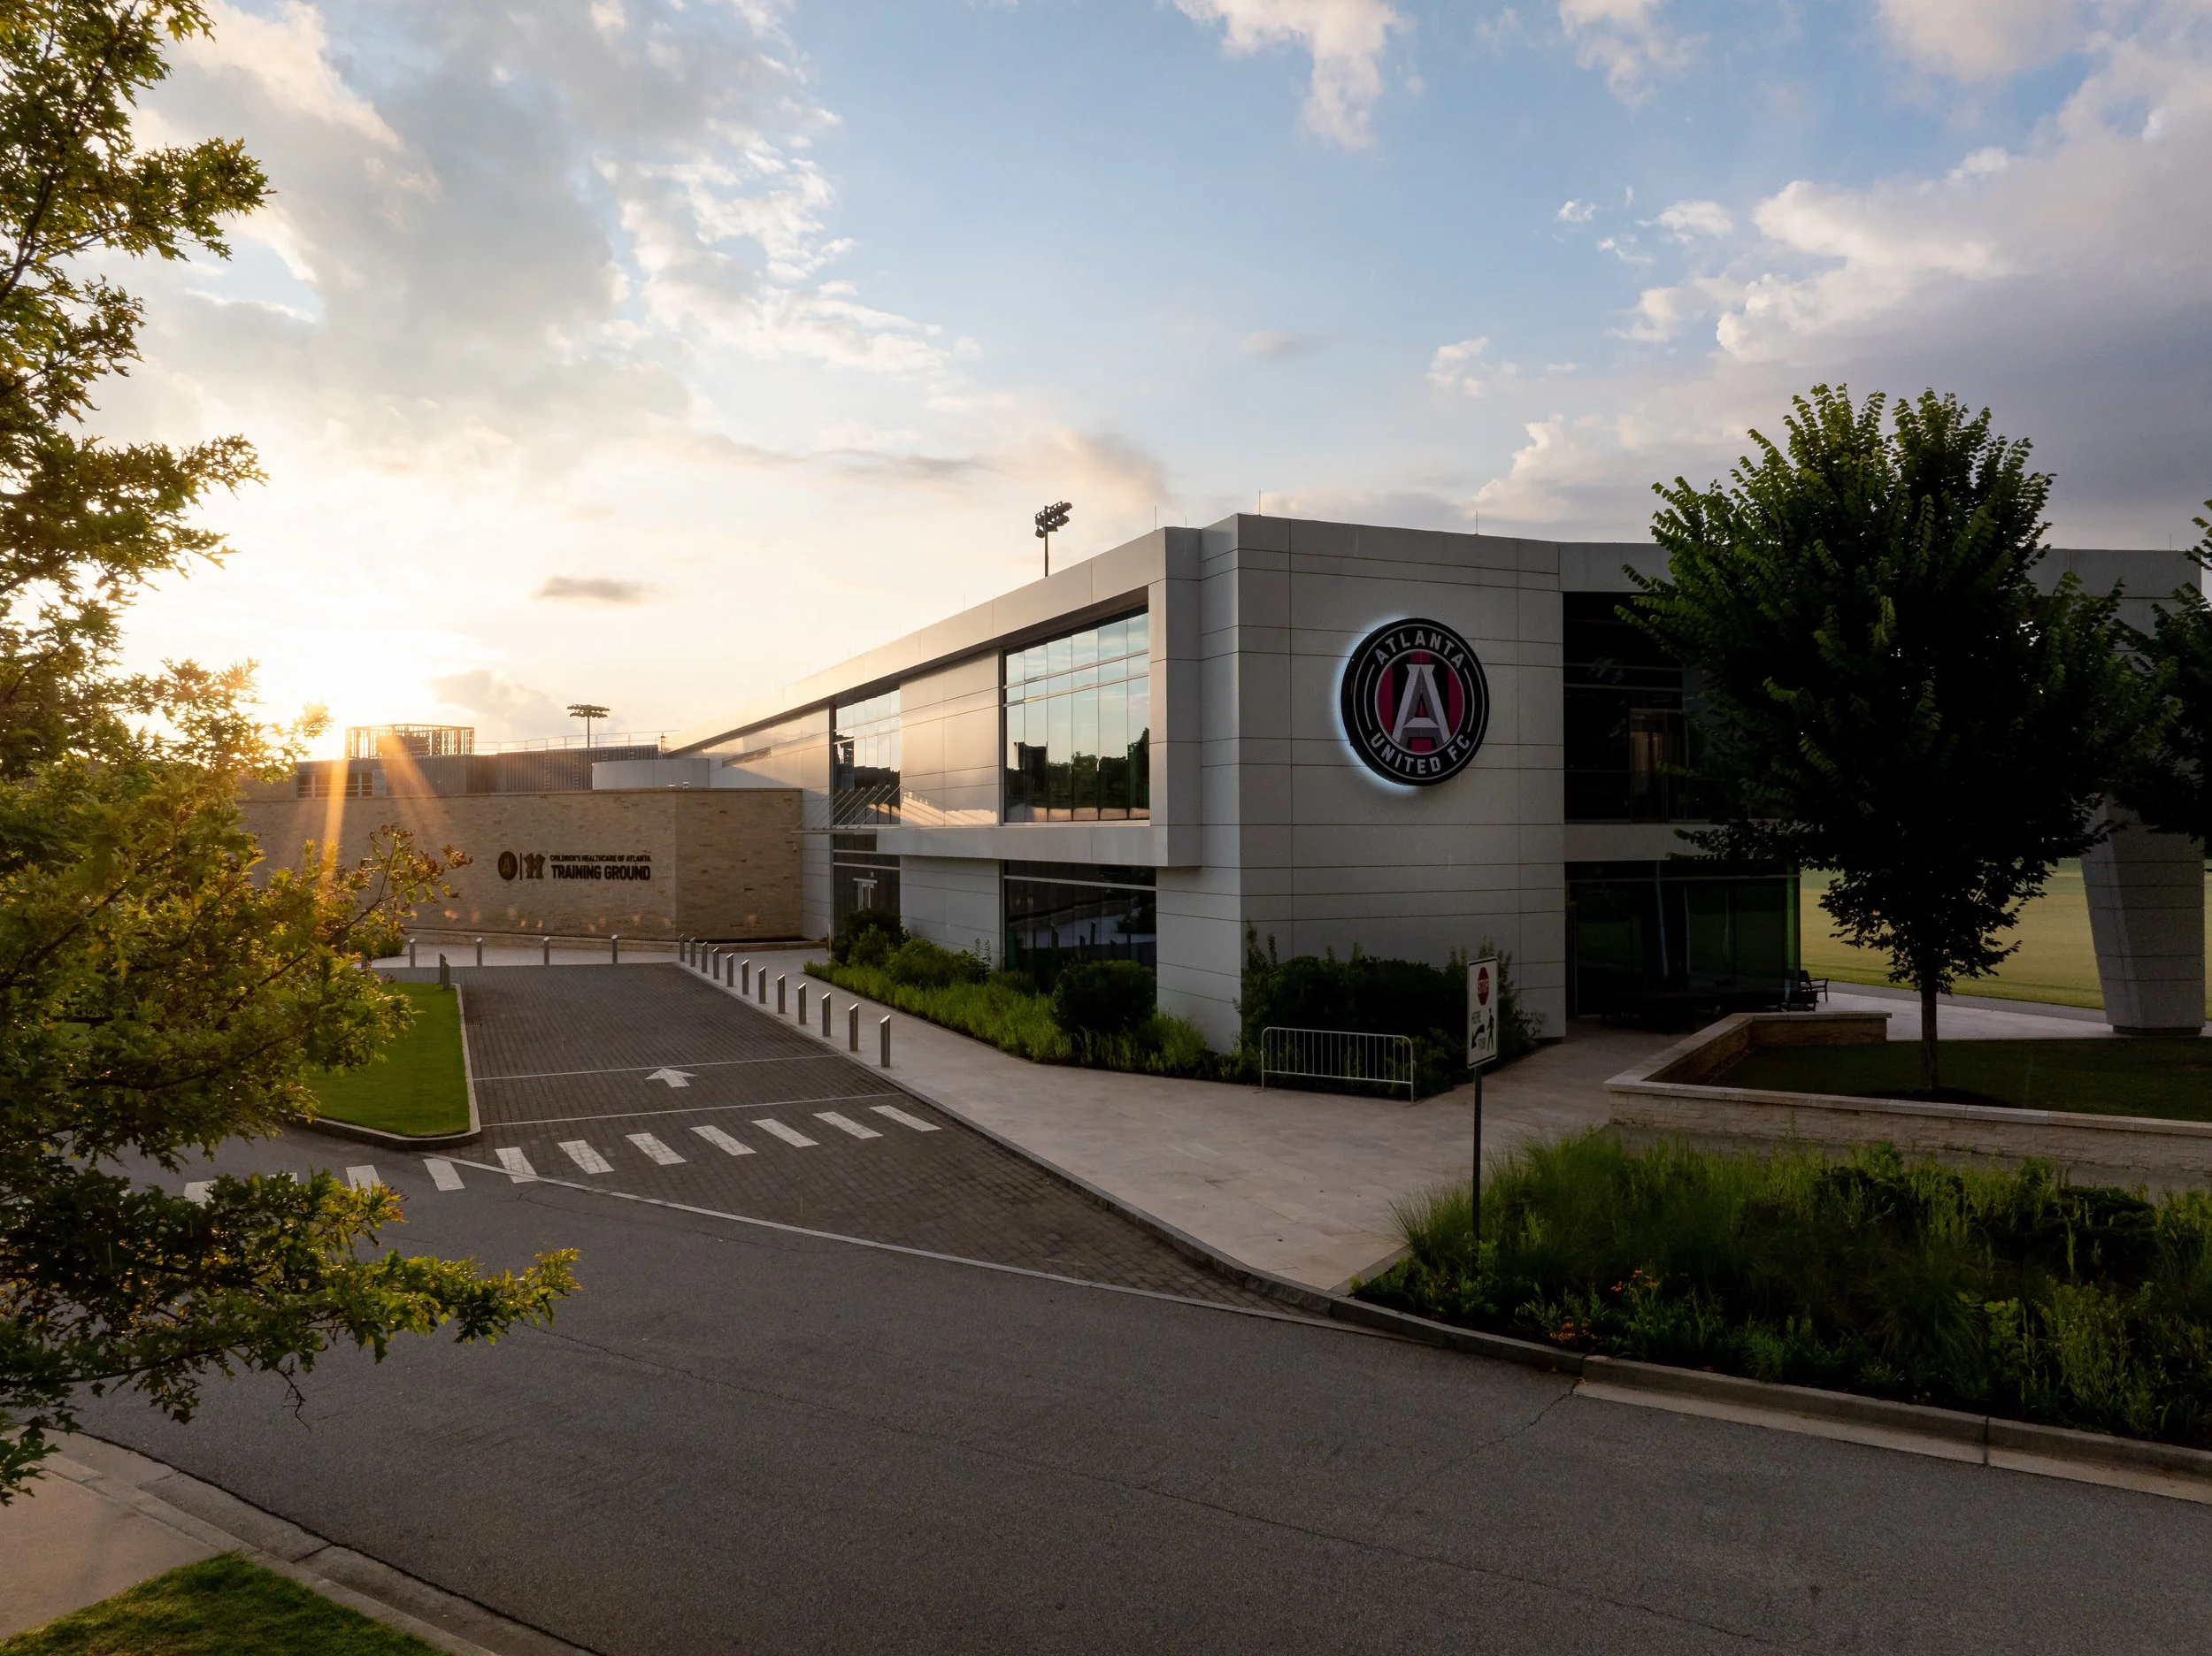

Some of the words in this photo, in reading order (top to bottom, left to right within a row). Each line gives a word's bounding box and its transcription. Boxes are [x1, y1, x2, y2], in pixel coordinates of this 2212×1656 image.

[1374, 630, 1466, 670] ATLANTA
[1391, 663, 1451, 750] A
[1370, 732, 1441, 775] UNITED
[1447, 734, 1471, 763] FC
[551, 865, 602, 880] TRAINING
[603, 864, 651, 880] GROUND
[1479, 978, 1488, 994] STOP
[1471, 1011, 1481, 1024] HERE
